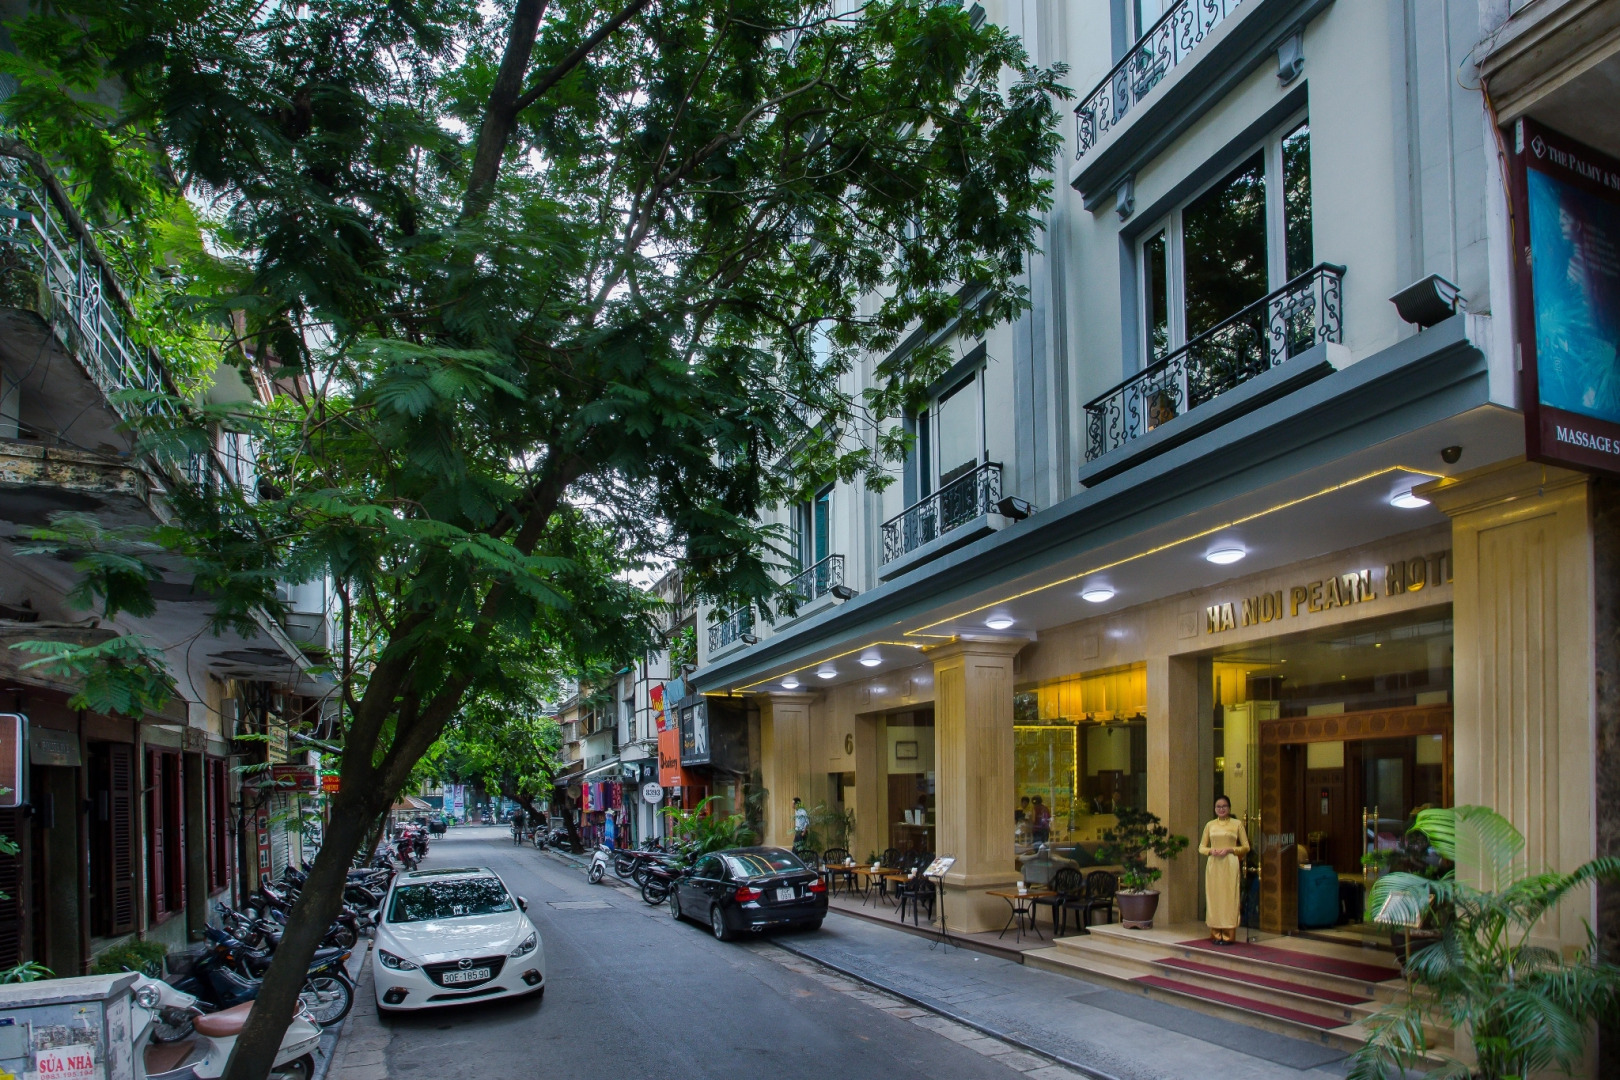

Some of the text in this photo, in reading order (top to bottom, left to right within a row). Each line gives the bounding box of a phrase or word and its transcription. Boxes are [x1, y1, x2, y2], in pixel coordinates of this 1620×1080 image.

[1548, 145, 1568, 167] THE
[1569, 153, 1602, 182] PALMY
[1556, 425, 1612, 453] MASSAGE
[1206, 602, 1236, 635] HA
[1241, 590, 1283, 628] NOI
[1290, 568, 1377, 617] PEARL
[844, 733, 854, 756] 6
[39, 1051, 94, 1074] SỬA NHÀ
